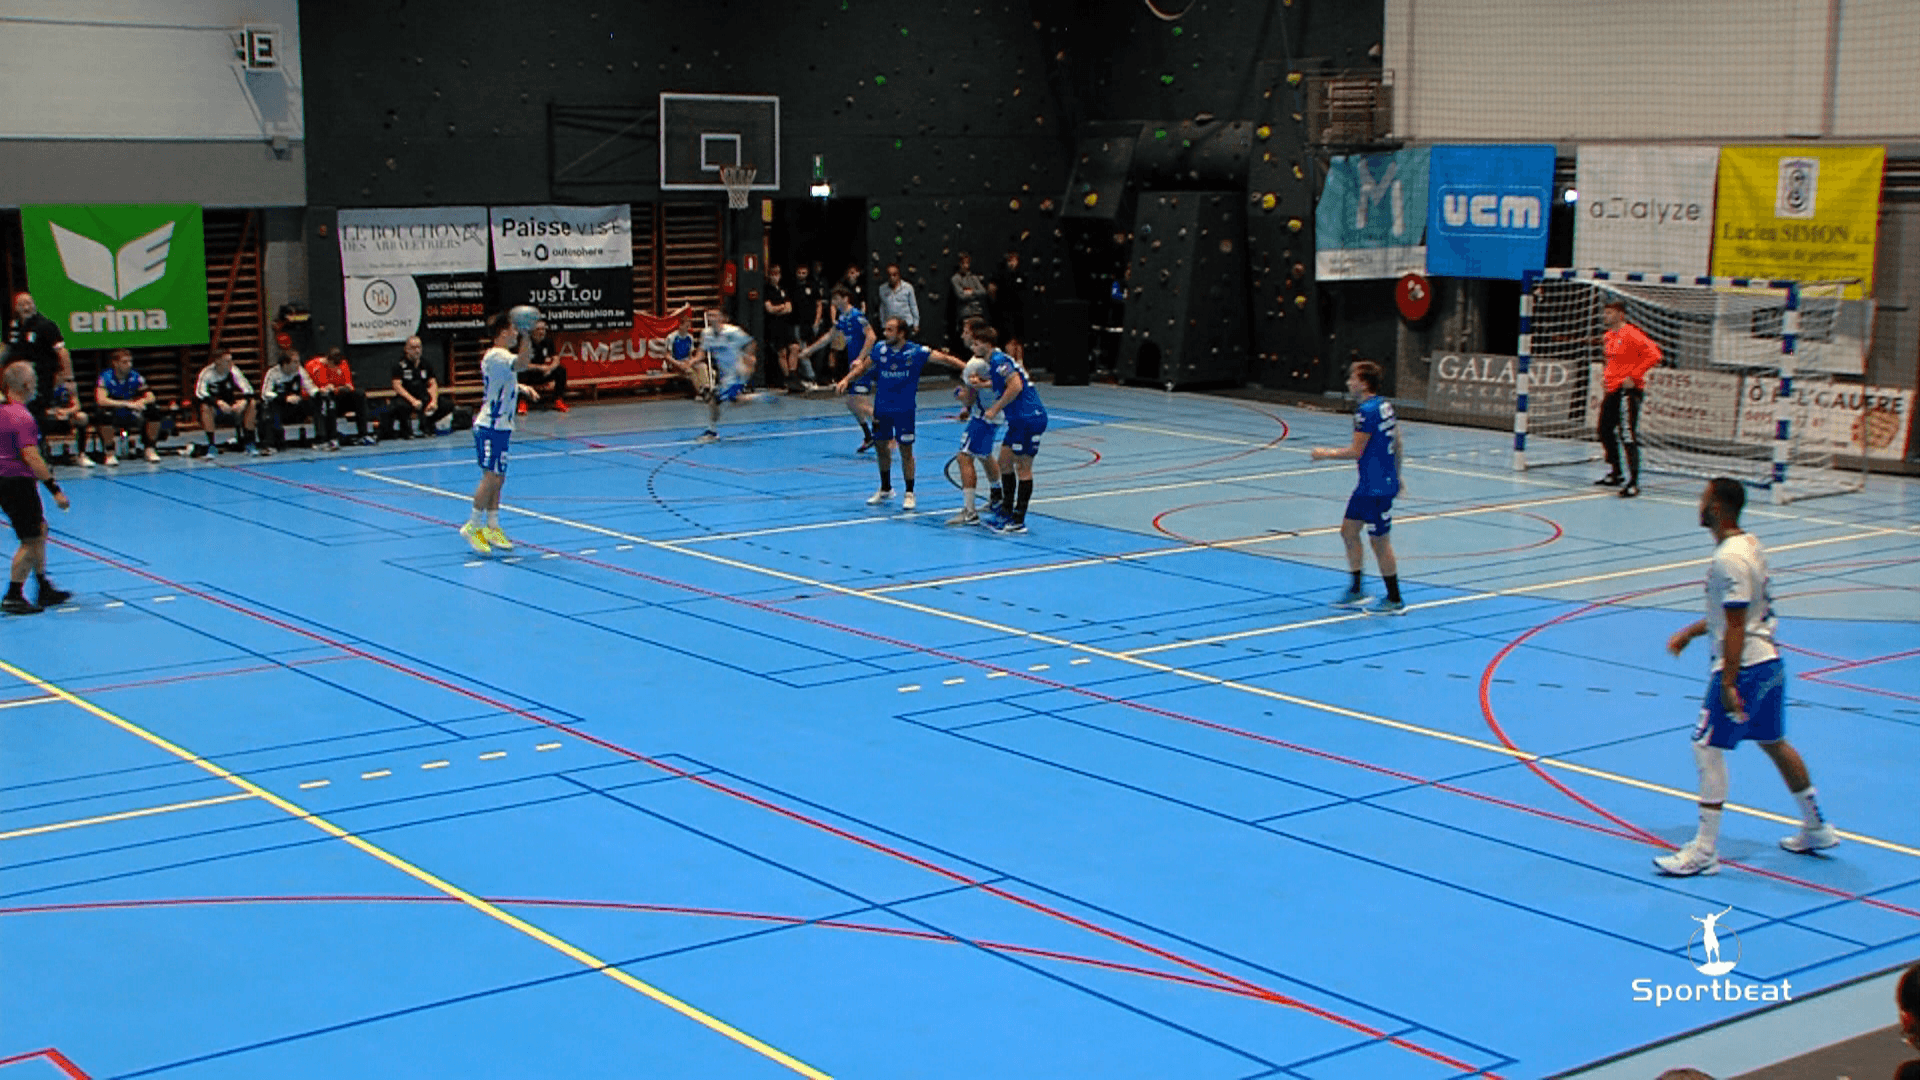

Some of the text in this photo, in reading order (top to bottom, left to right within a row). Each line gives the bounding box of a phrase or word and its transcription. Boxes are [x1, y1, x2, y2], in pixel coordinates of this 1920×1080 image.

[371, 222, 460, 240] BOUCHON
[502, 216, 571, 237] Paisse
[521, 249, 531, 257] by
[529, 289, 602, 303] JUST LOU
[70, 305, 168, 333] erima
[581, 338, 668, 362] MEUS
[1438, 355, 1568, 387] GALAND
